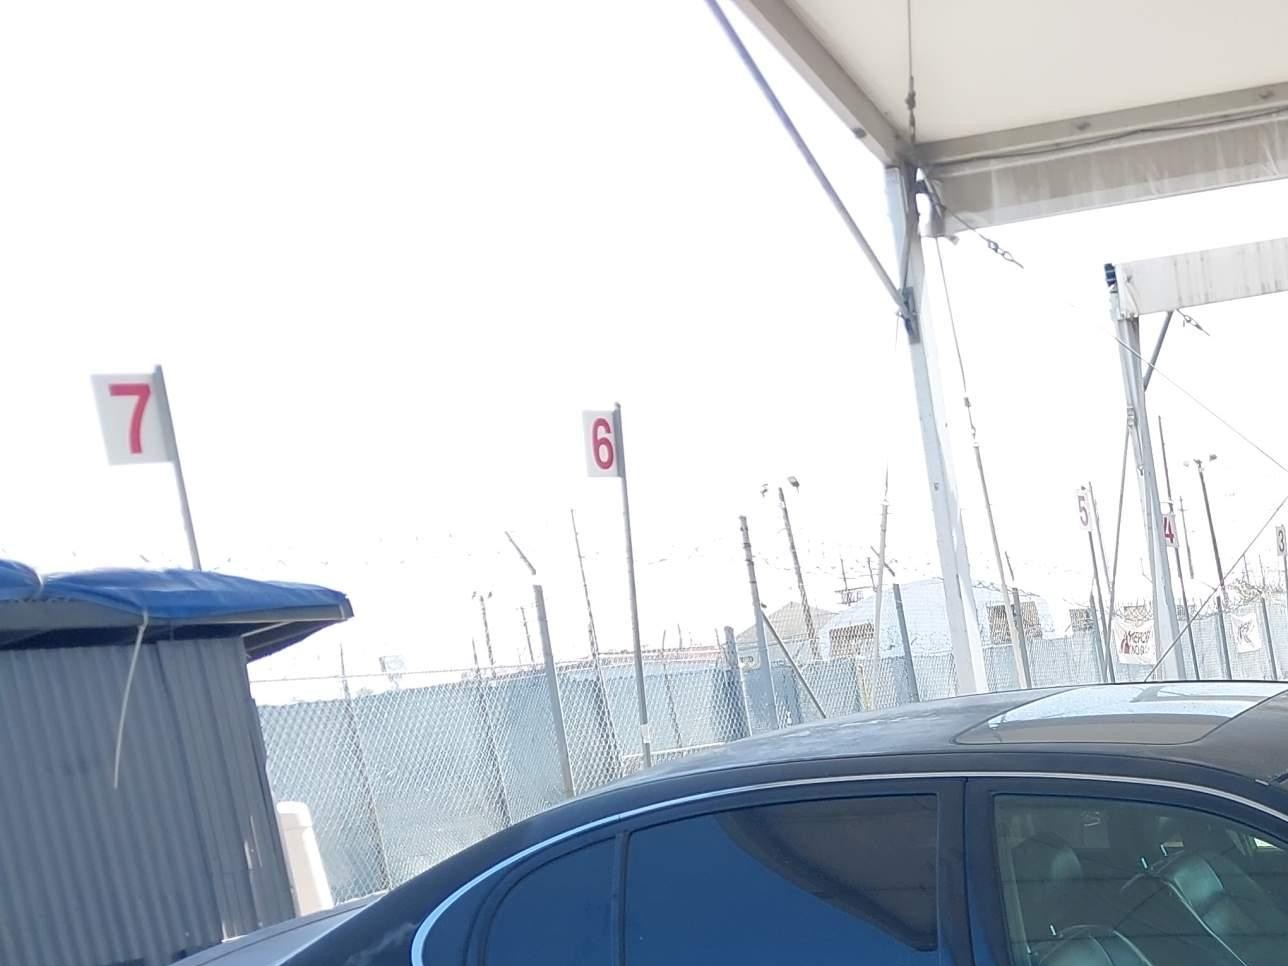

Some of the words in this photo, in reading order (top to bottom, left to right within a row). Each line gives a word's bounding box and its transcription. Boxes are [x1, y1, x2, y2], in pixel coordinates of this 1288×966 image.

[109, 383, 151, 454] 7
[592, 417, 614, 470] 6
[1078, 495, 1089, 527] 5
[1164, 517, 1175, 544] 4
[1278, 529, 1285, 553] 3
